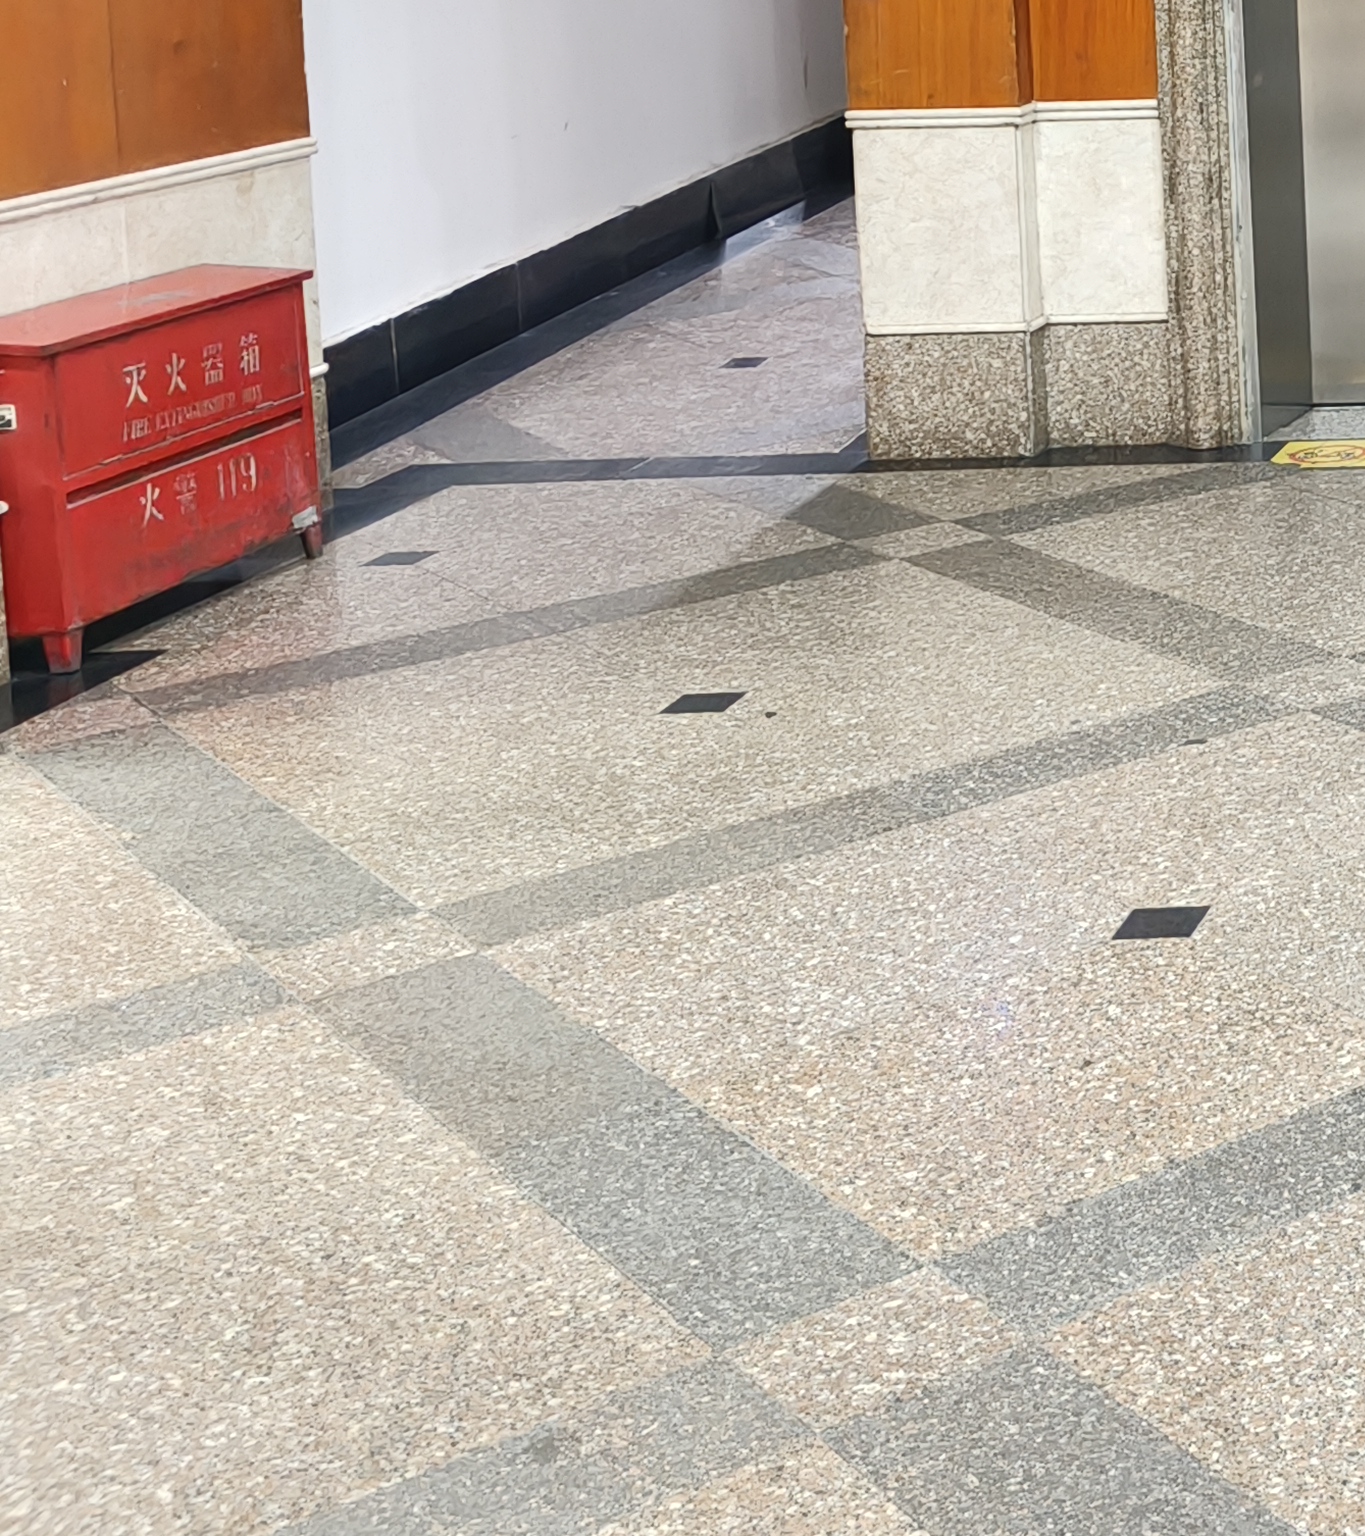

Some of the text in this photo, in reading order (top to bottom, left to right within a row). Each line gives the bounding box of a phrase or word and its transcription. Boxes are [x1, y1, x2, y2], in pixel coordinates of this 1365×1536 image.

[122, 331, 262, 409] 灭火器箱
[217, 452, 258, 501] 119
